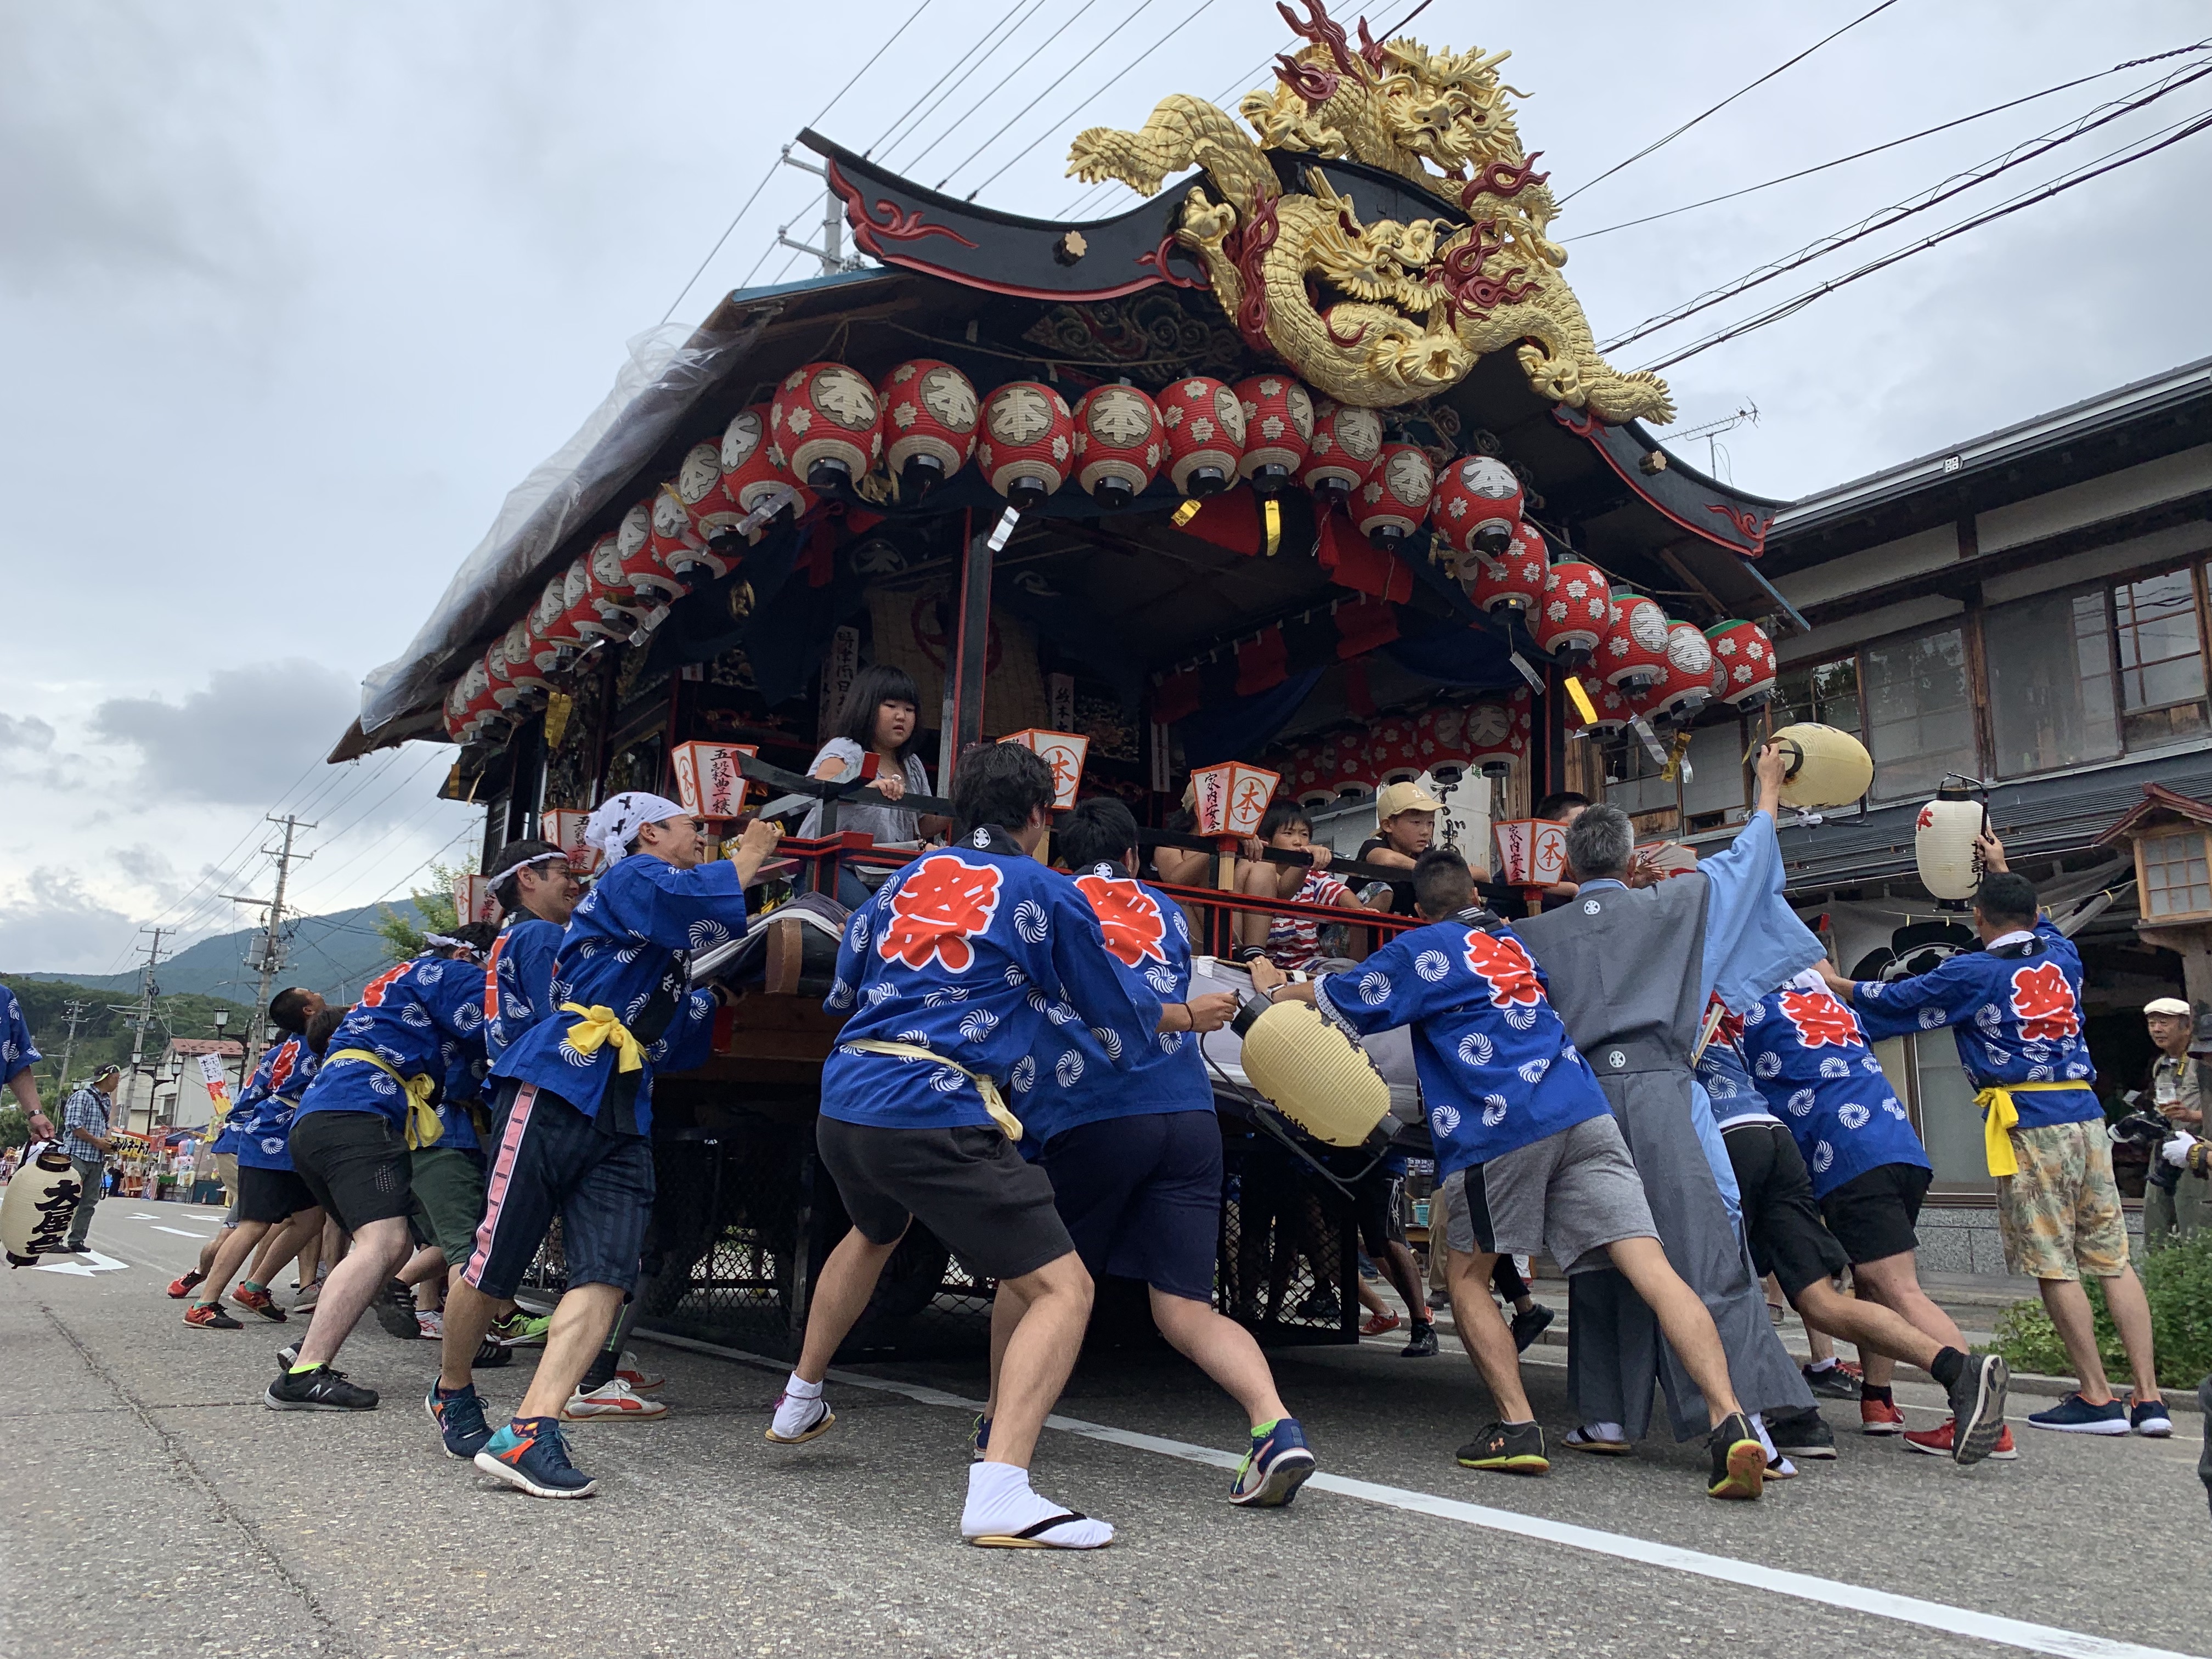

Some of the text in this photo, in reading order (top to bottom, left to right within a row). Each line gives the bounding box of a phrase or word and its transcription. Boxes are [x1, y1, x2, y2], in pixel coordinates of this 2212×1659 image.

[817, 370, 874, 425] 本
[927, 370, 978, 426] 本
[991, 388, 1049, 442] 本
[1093, 391, 1148, 443] 本
[1390, 452, 1432, 503] 本
[1470, 706, 1509, 744] 大
[710, 748, 733, 816] 五穀豊穣
[1204, 772, 1221, 833] 家内安全
[1233, 781, 1263, 820] 本
[1509, 824, 1526, 883] 家内安全
[1539, 833, 1564, 867] 本
[877, 855, 1003, 974] 祭
[2010, 960, 2080, 1042] 祭
